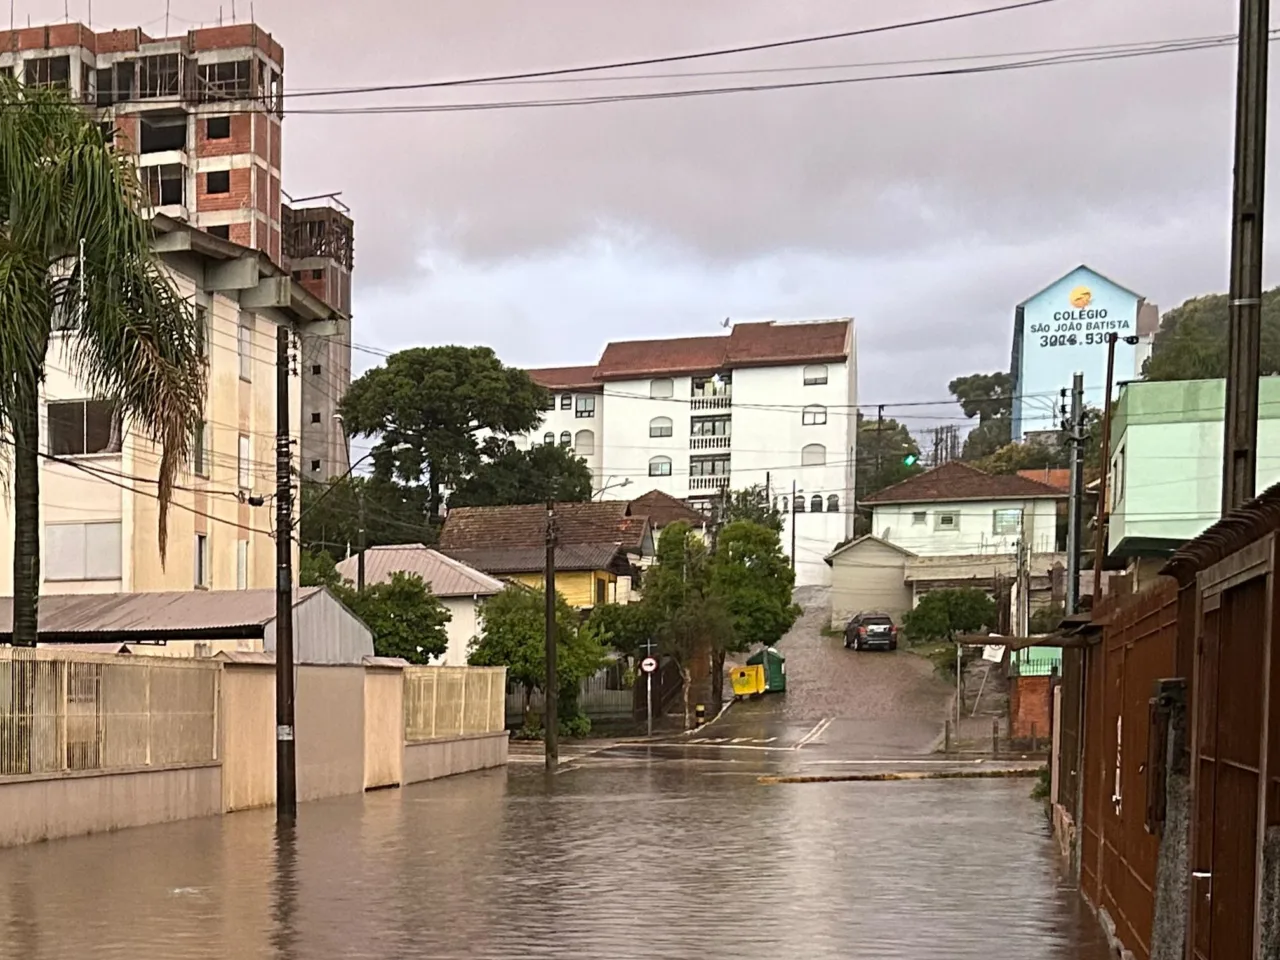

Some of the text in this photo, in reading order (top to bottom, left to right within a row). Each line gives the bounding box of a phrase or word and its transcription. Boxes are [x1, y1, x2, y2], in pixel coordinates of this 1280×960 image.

[1053, 308, 1108, 321] COLÉGIO
[1030, 320, 1130, 333] SÃO JOÃO BATISTA
